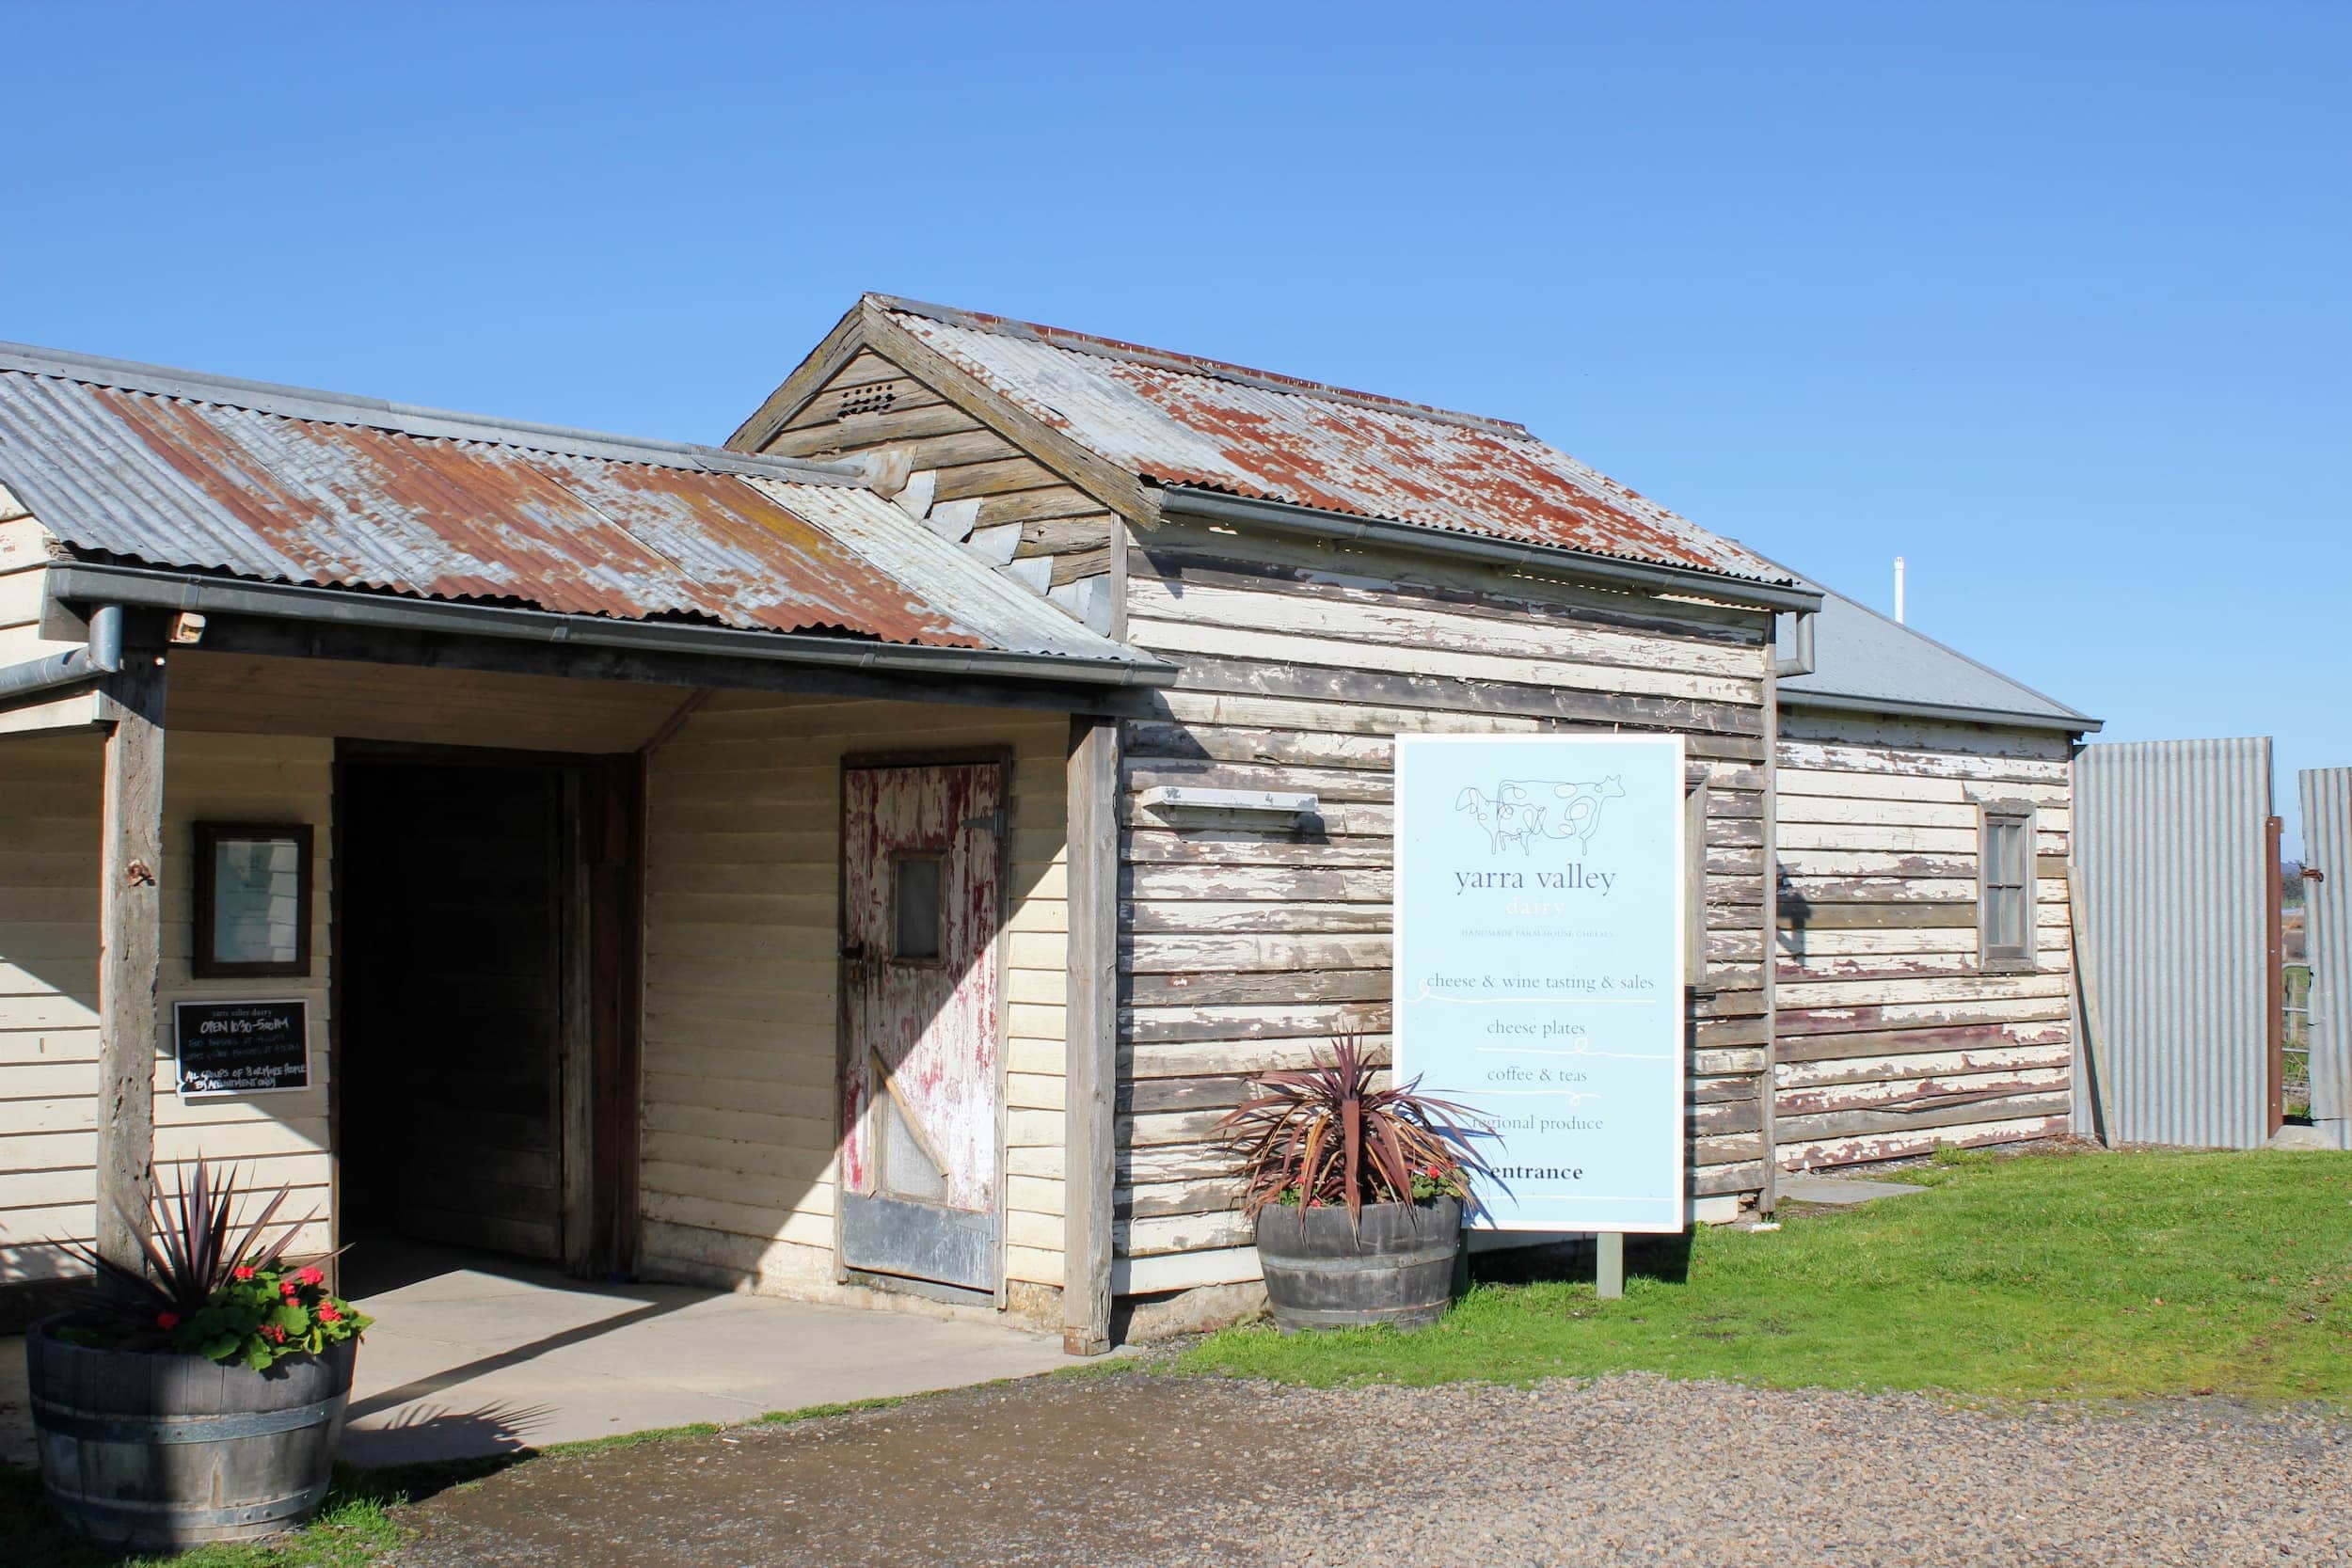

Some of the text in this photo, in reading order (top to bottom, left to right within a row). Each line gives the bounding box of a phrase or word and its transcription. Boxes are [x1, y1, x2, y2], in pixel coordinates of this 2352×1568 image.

[1454, 863, 1616, 896] yarra valley
[1505, 897, 1566, 918] dairy
[1426, 973, 1654, 992] cheese & wine tasting & sales
[200, 1021, 228, 1034] OPEN
[1486, 1020, 1585, 1038] cheese plates
[232, 1069, 244, 1077] OF
[1487, 1066, 1587, 1082] coffee & teas
[1472, 1115, 1603, 1133] regional produce
[1490, 1165, 1583, 1180] entrance
